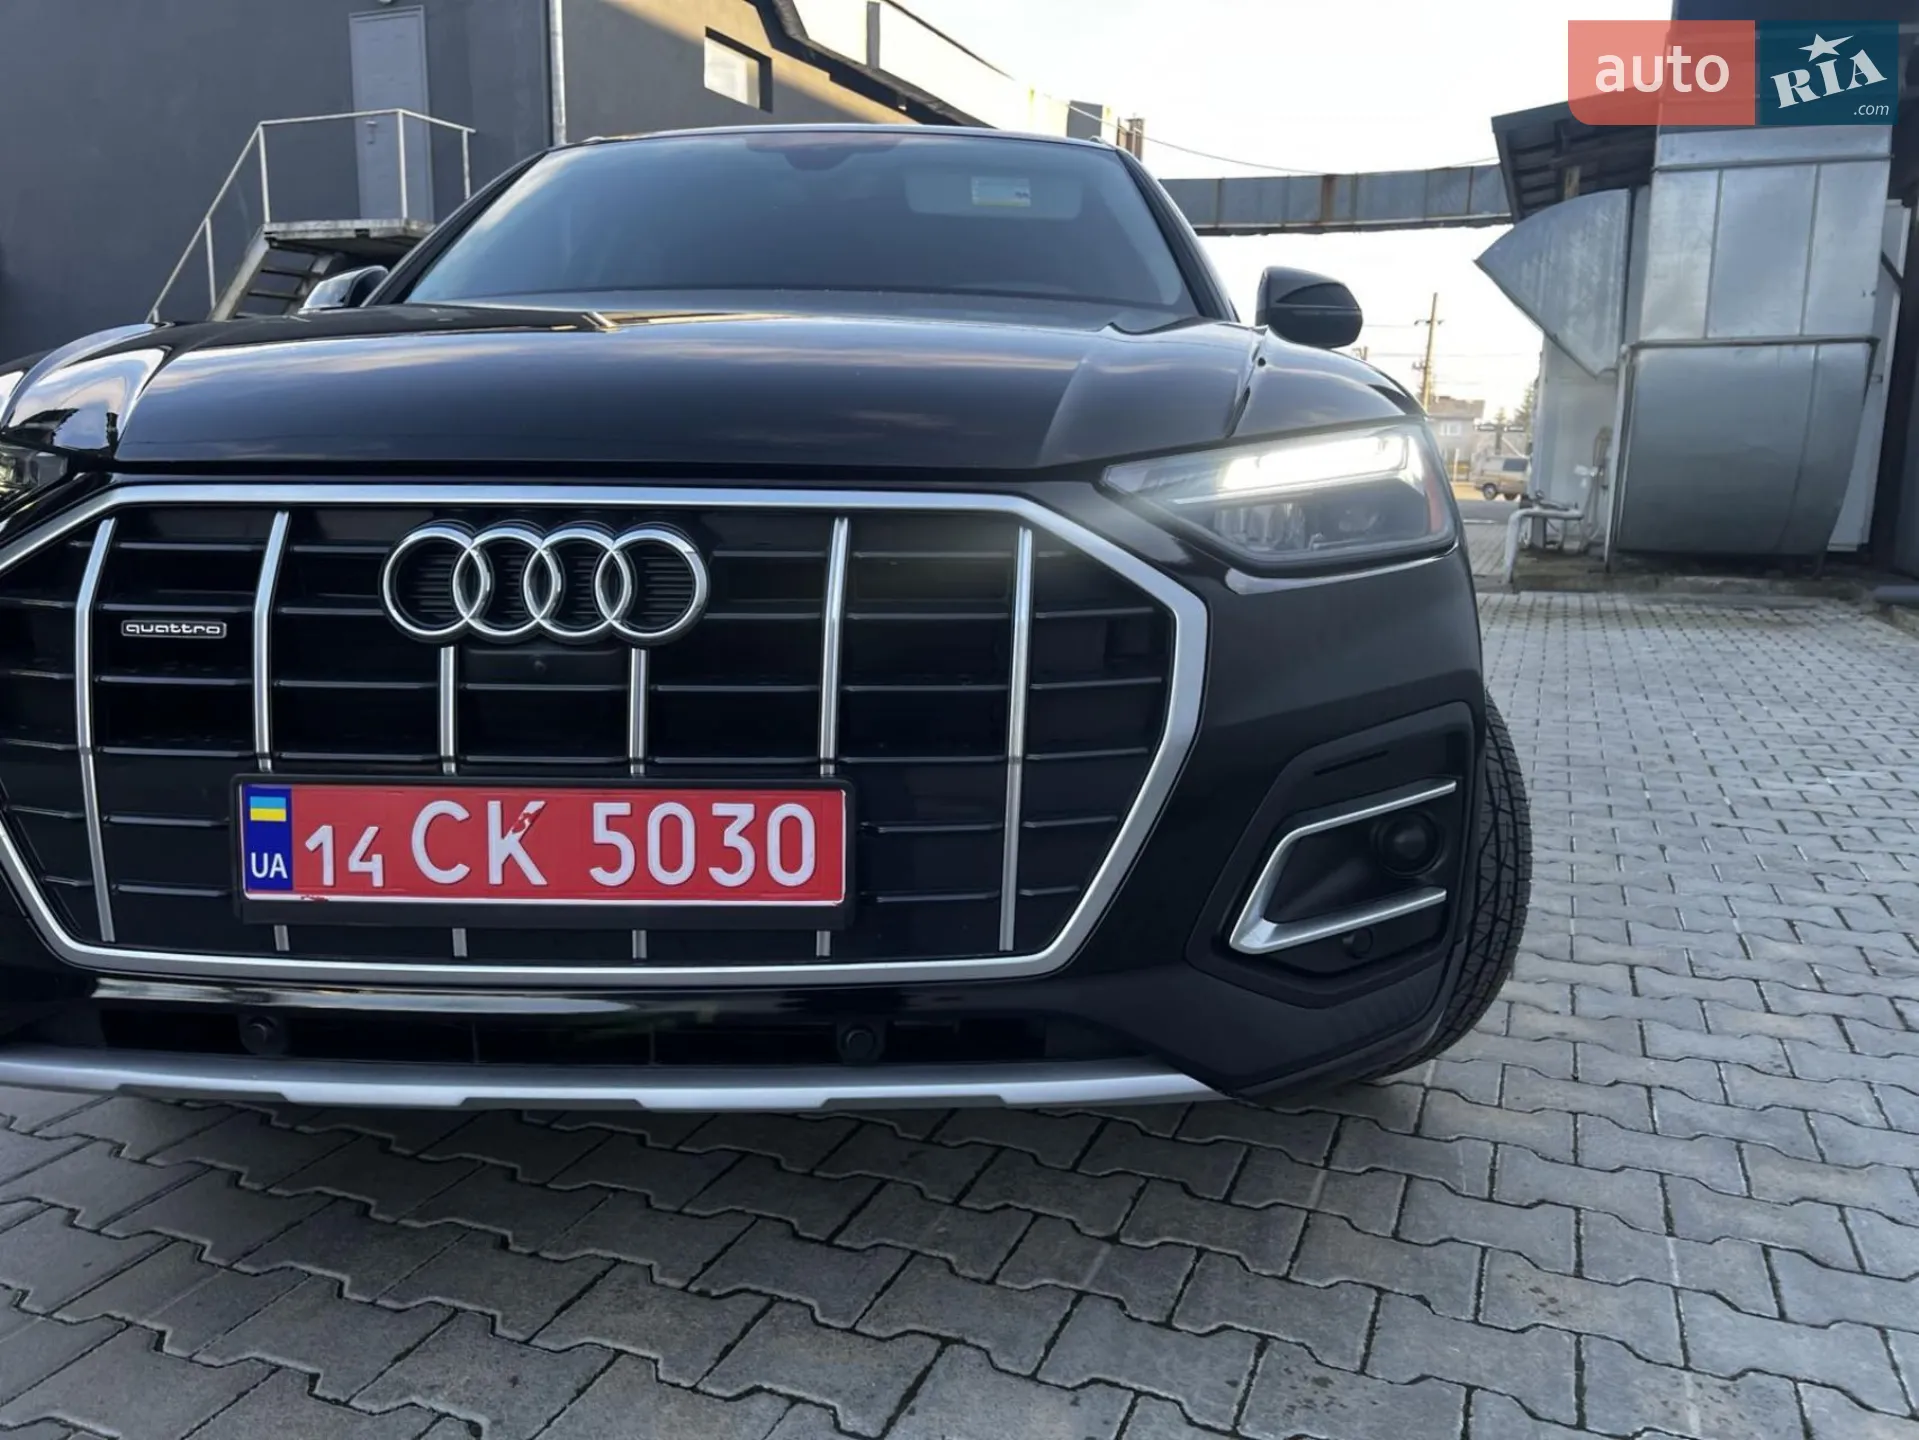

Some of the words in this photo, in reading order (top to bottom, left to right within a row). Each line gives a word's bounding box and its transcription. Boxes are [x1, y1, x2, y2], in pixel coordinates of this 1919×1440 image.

[126, 624, 220, 634] quattro
[304, 824, 384, 887] 14
[411, 800, 547, 886] CK
[589, 802, 816, 887] 5030
[250, 853, 288, 879] UA
